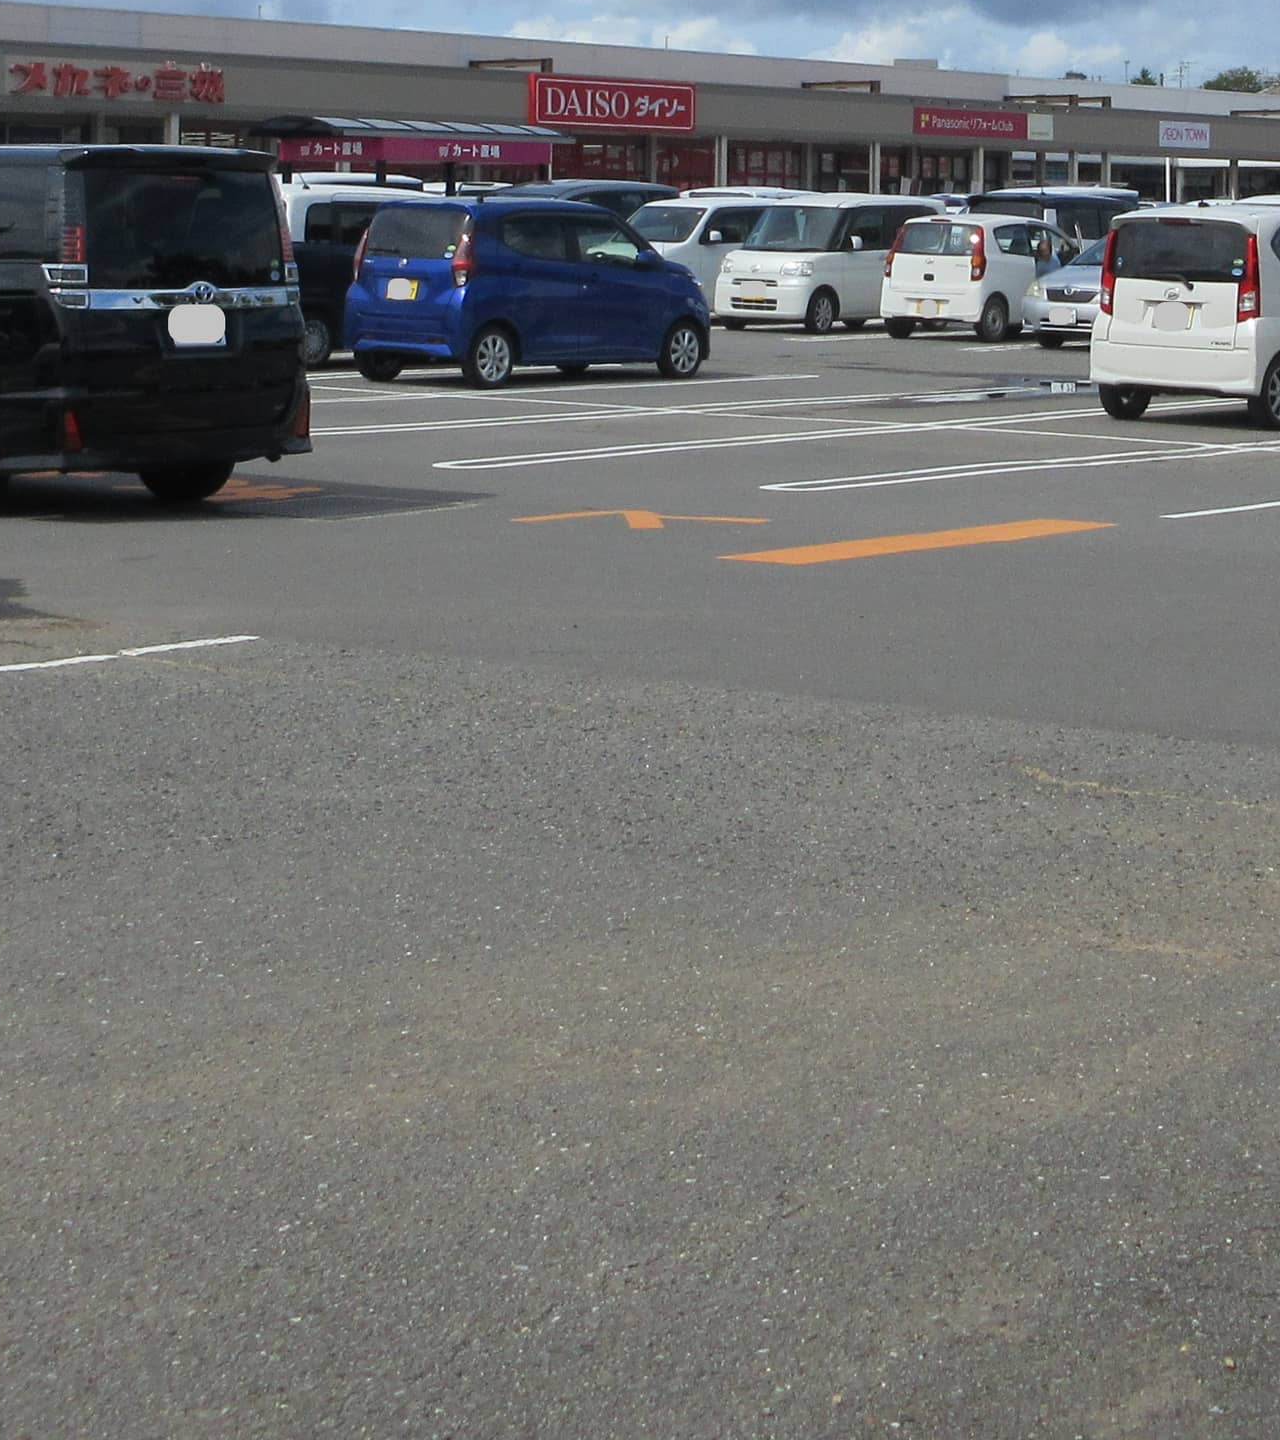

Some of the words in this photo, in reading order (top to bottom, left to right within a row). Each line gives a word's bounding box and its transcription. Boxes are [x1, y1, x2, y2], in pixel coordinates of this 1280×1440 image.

[544, 87, 629, 119] DAISO
[635, 95, 686, 118] ダイソー
